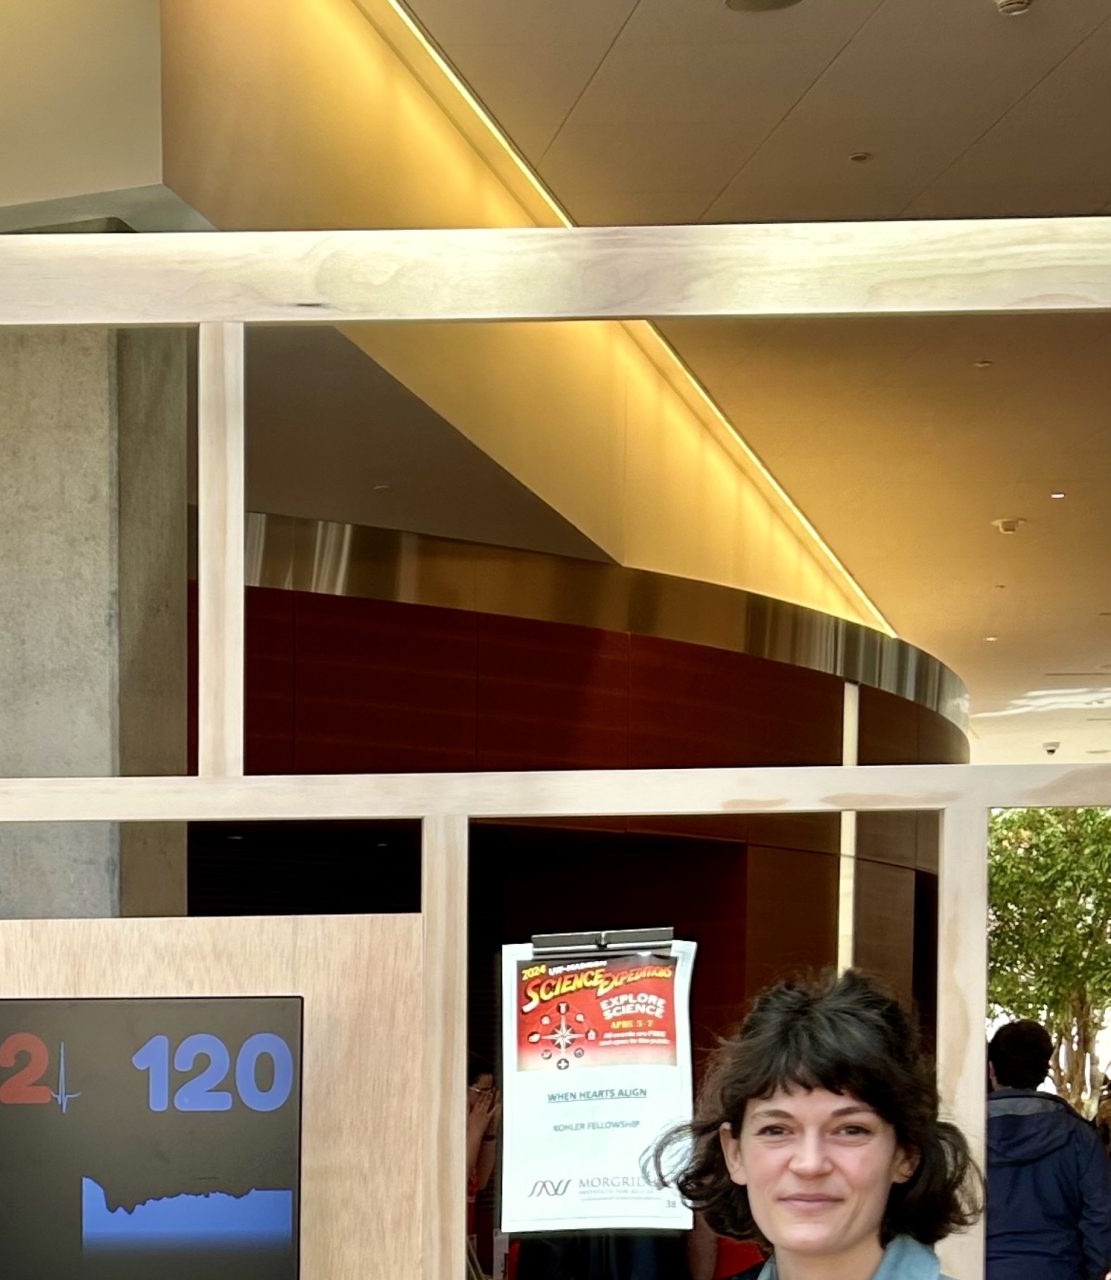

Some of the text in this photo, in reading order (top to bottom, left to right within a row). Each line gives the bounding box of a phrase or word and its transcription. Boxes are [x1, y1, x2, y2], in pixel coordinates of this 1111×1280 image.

[521, 965, 546, 980] 2024
[521, 965, 673, 1013] SCIENCE EXPEDITIONS
[599, 993, 666, 1011] EXPLORE
[602, 1004, 665, 1021] SCIENCE
[131, 1032, 294, 1112] 120
[548, 1088, 648, 1102] WHEN HEARTS ALIGN
[553, 1120, 640, 1132] KOHLER FELLOWSHIP
